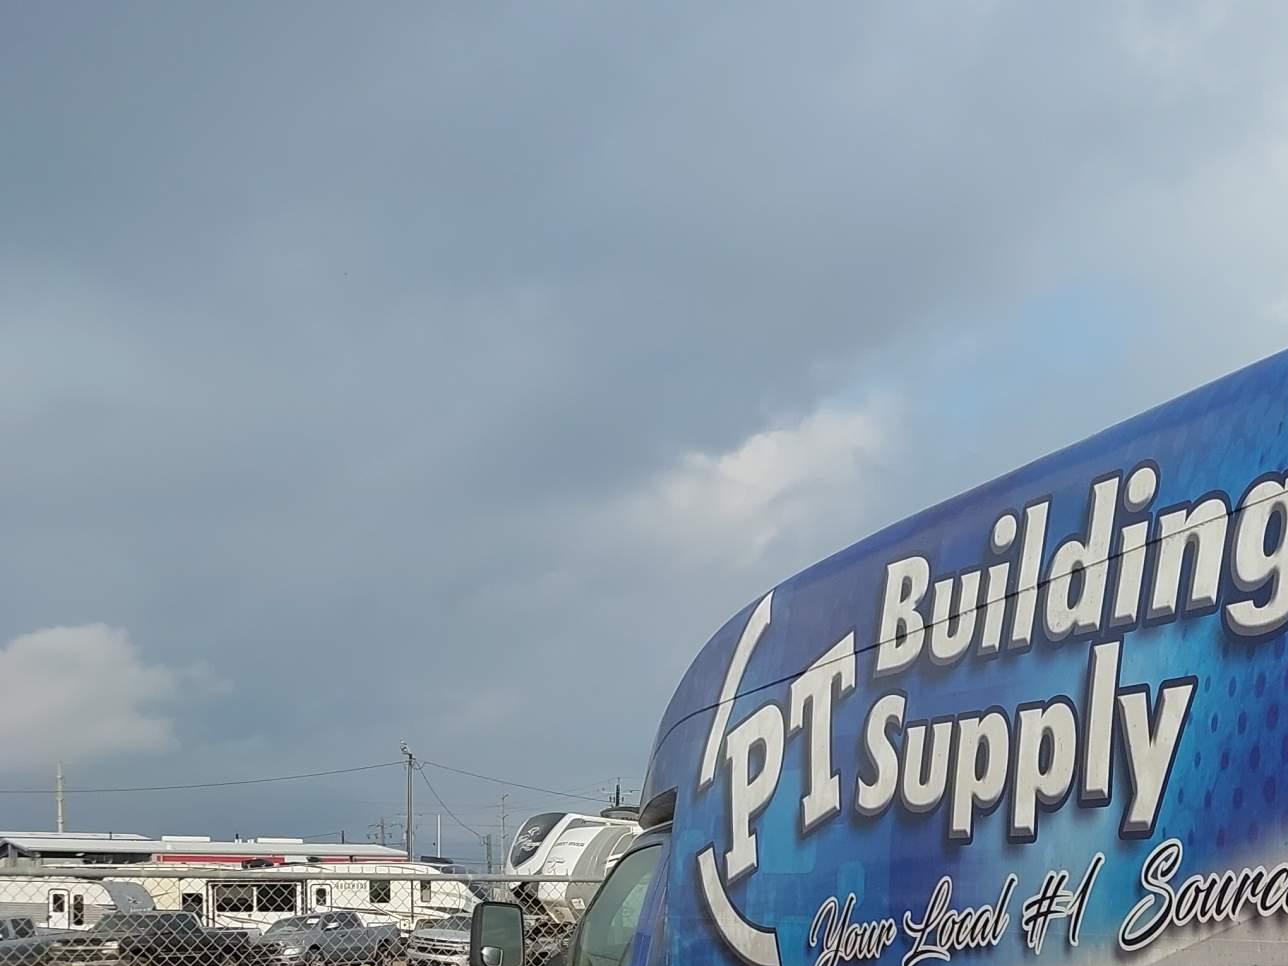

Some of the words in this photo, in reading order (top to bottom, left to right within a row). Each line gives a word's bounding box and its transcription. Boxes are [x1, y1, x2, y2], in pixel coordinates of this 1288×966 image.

[723, 632, 857, 884] PT
[857, 639, 1198, 840] Supply
[1021, 852, 1105, 955] #1
